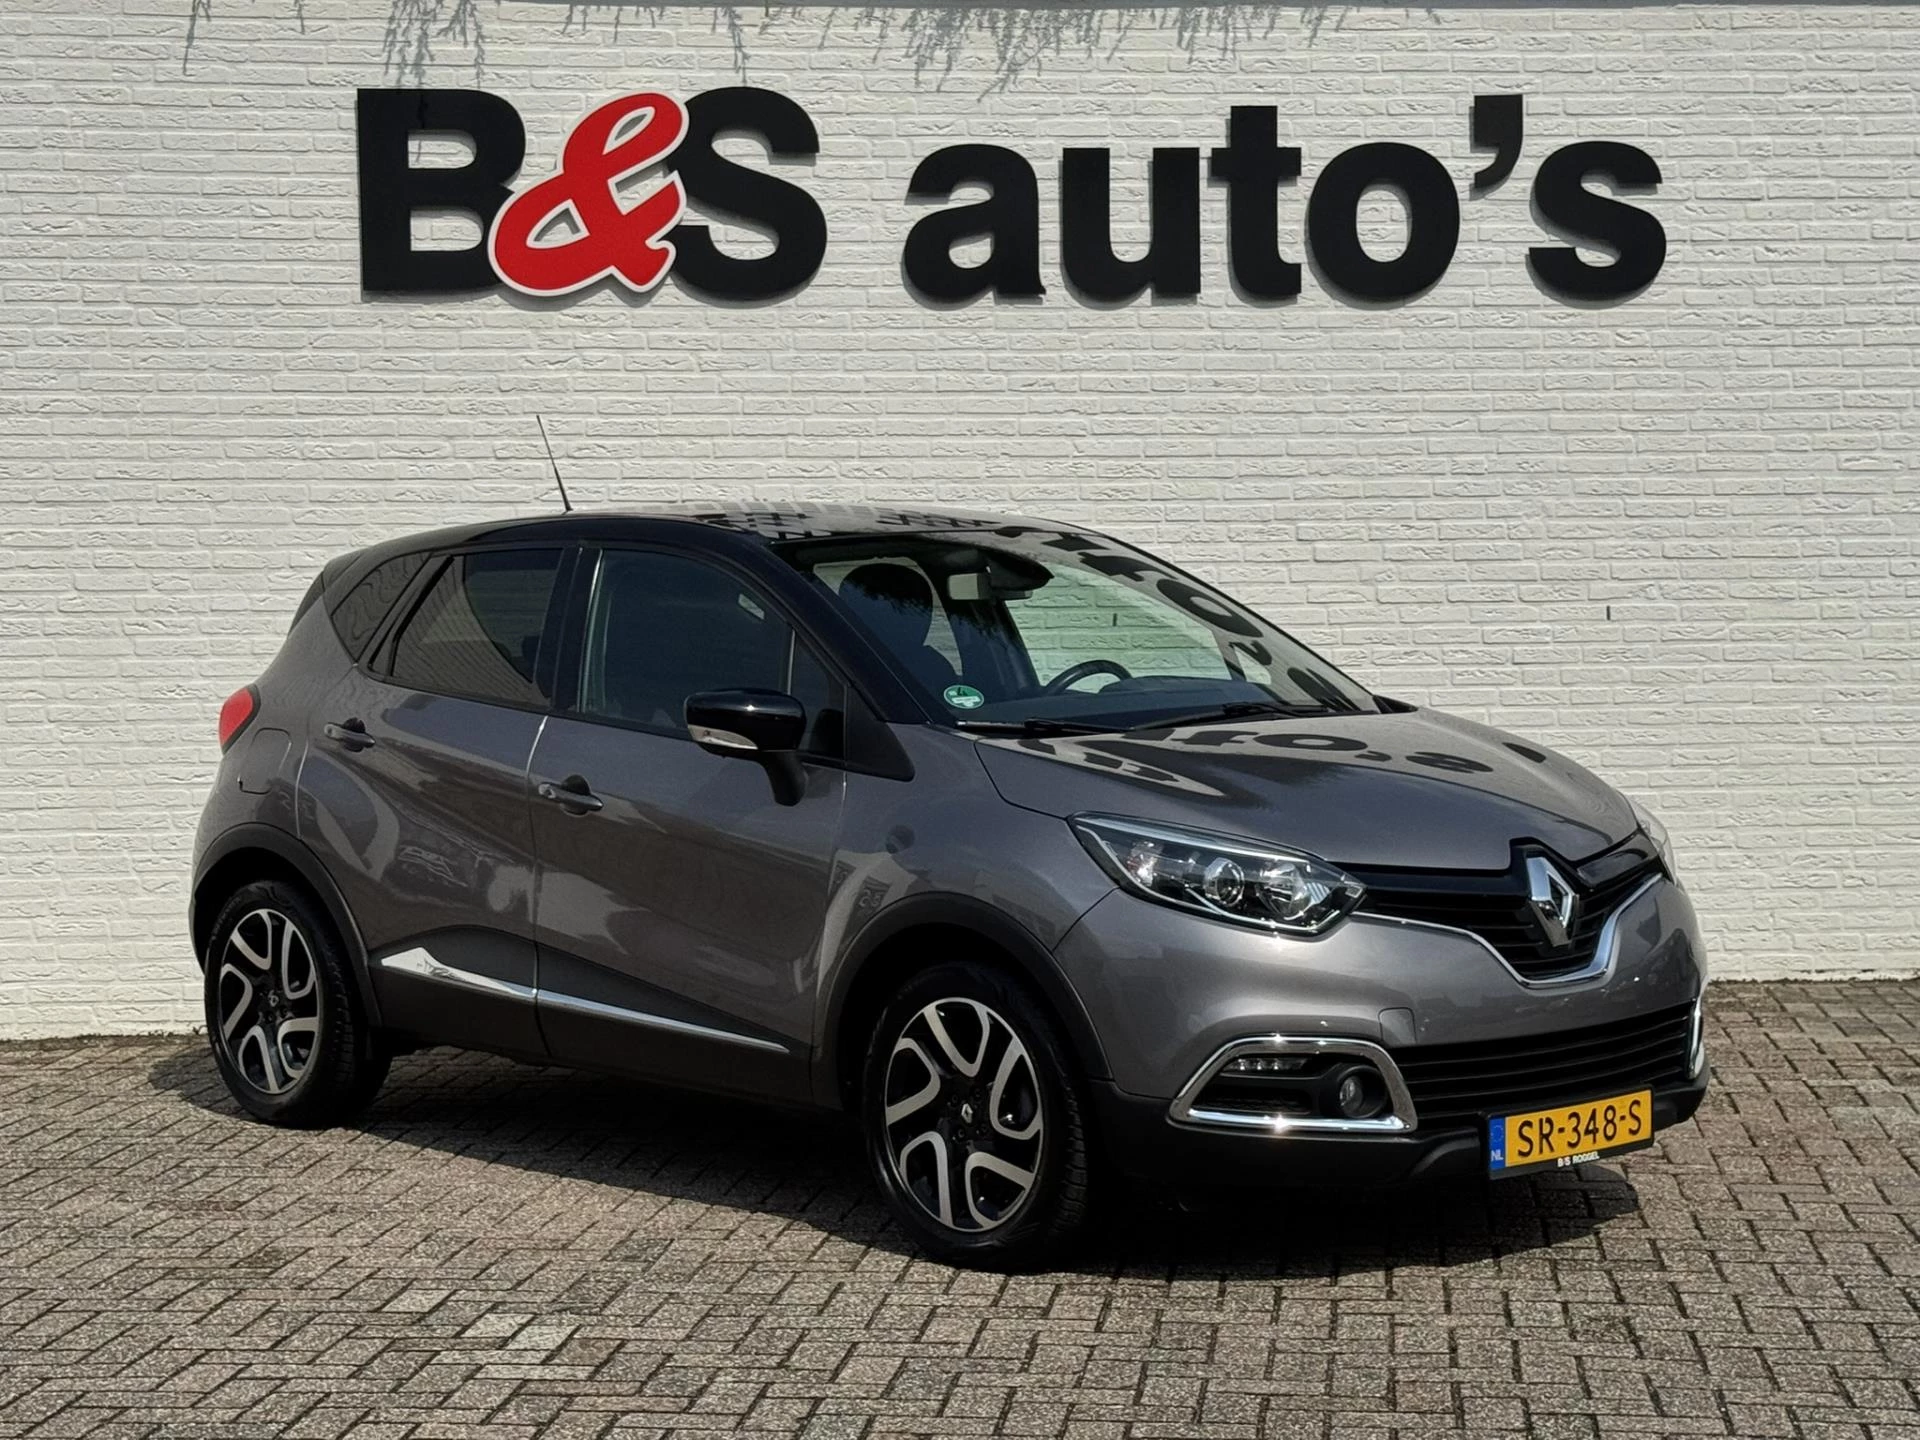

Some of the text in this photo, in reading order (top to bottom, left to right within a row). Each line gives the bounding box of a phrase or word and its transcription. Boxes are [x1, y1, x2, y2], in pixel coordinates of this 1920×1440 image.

[357, 87, 1667, 302] B&S auto's
[1491, 1149, 1504, 1162] NL
[1517, 1098, 1643, 1158] SR-348-S
